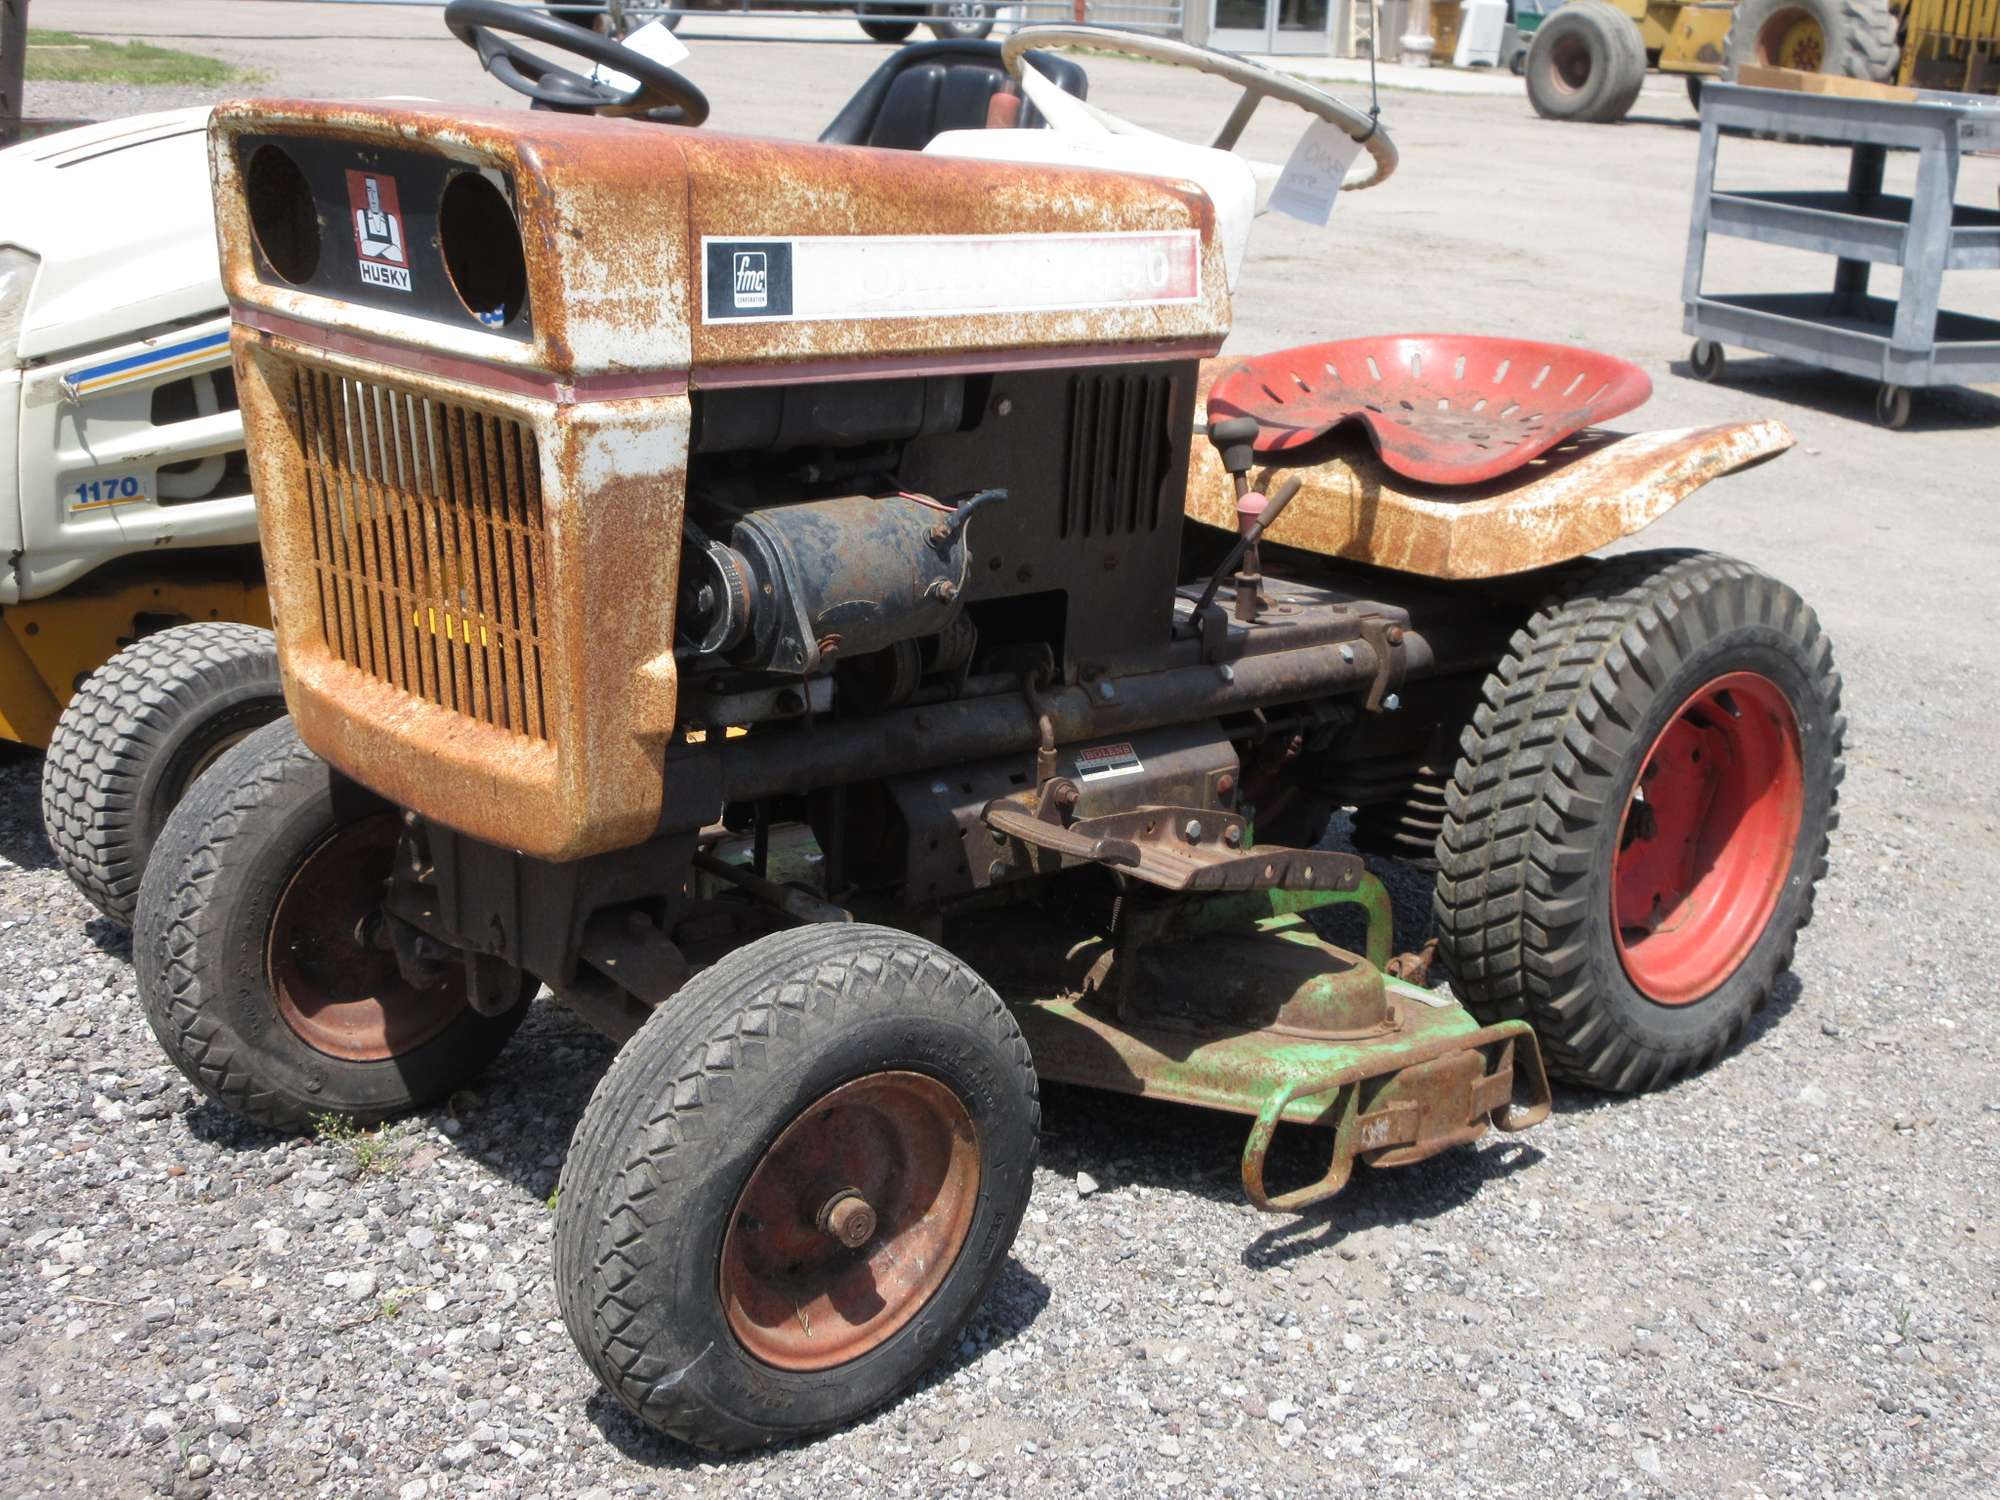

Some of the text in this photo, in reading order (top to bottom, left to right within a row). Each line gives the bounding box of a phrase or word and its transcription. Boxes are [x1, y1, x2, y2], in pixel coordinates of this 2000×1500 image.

[361, 263, 408, 288] HUSKY
[737, 255, 765, 291] fmc
[75, 476, 138, 504] 1170
